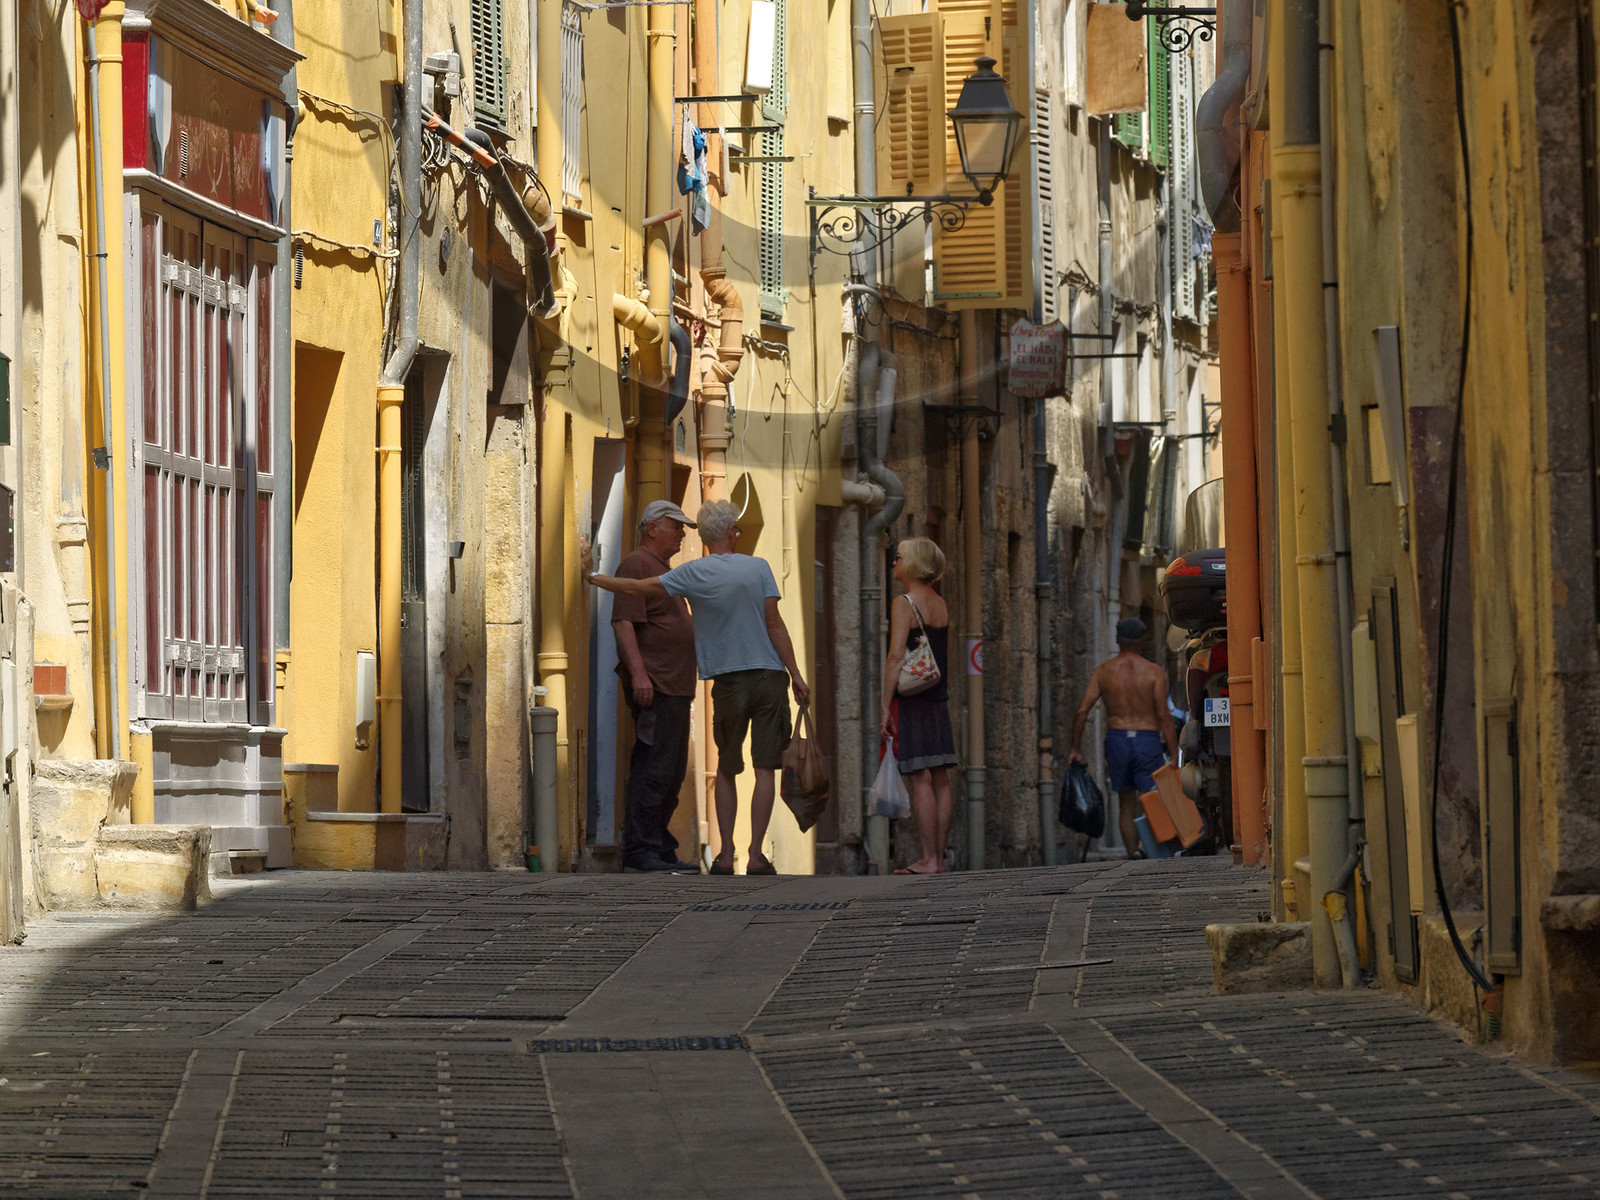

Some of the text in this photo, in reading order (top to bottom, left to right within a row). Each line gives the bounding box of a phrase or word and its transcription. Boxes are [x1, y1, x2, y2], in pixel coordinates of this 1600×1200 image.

[1017, 344, 1027, 353] EL
[1017, 355, 1026, 364] EL
[1211, 713, 1230, 723] BXN
